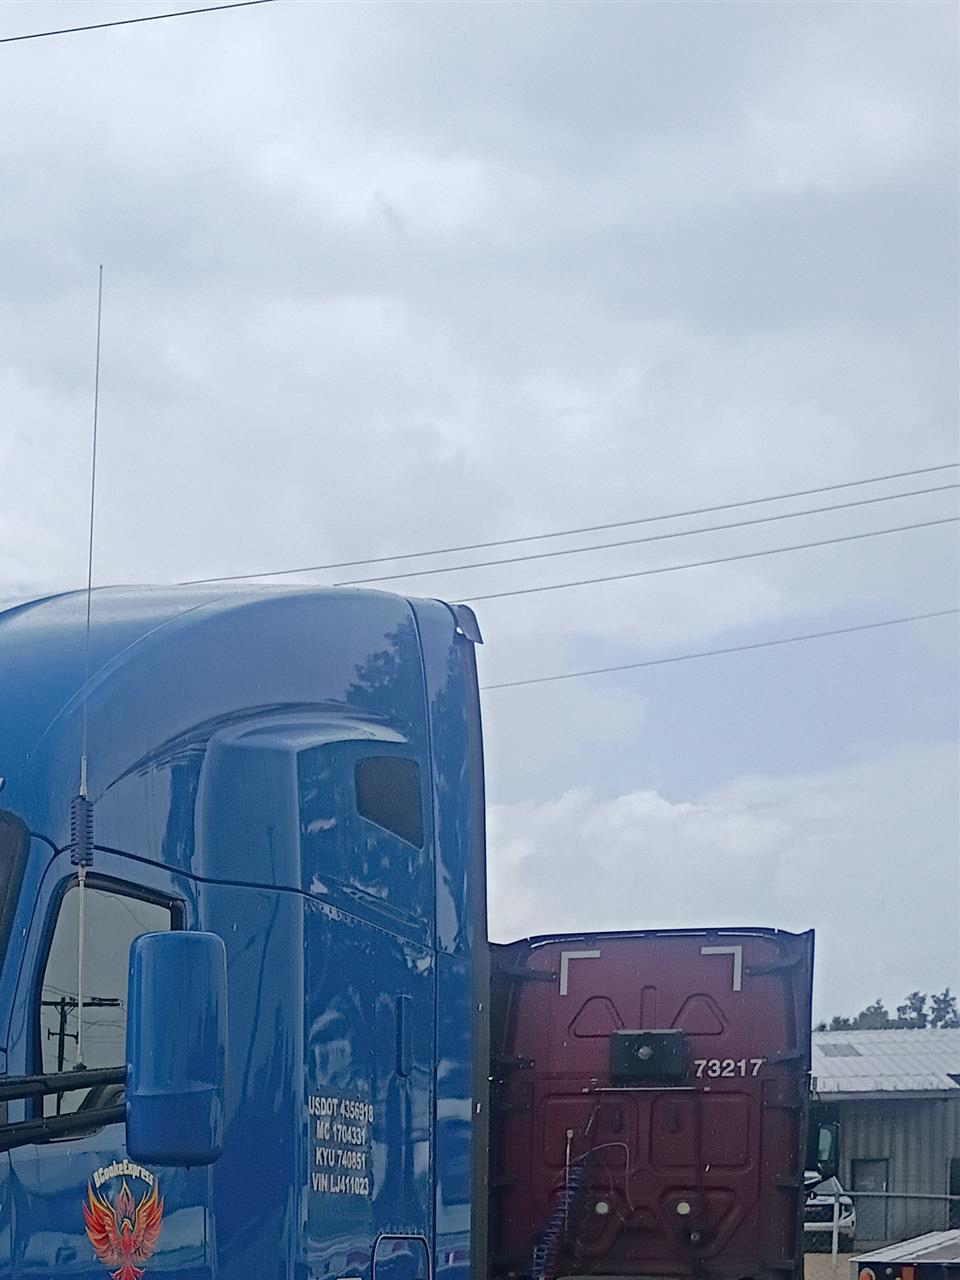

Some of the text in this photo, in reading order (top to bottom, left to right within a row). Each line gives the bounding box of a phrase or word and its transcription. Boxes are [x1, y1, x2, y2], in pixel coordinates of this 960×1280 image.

[694, 1058, 763, 1077] 73217
[308, 1095, 374, 1122] USDOT 4356918
[316, 1120, 365, 1145] MC 1704331
[316, 1147, 366, 1170] KYU 740851
[312, 1172, 369, 1196] VIN LJ411023
